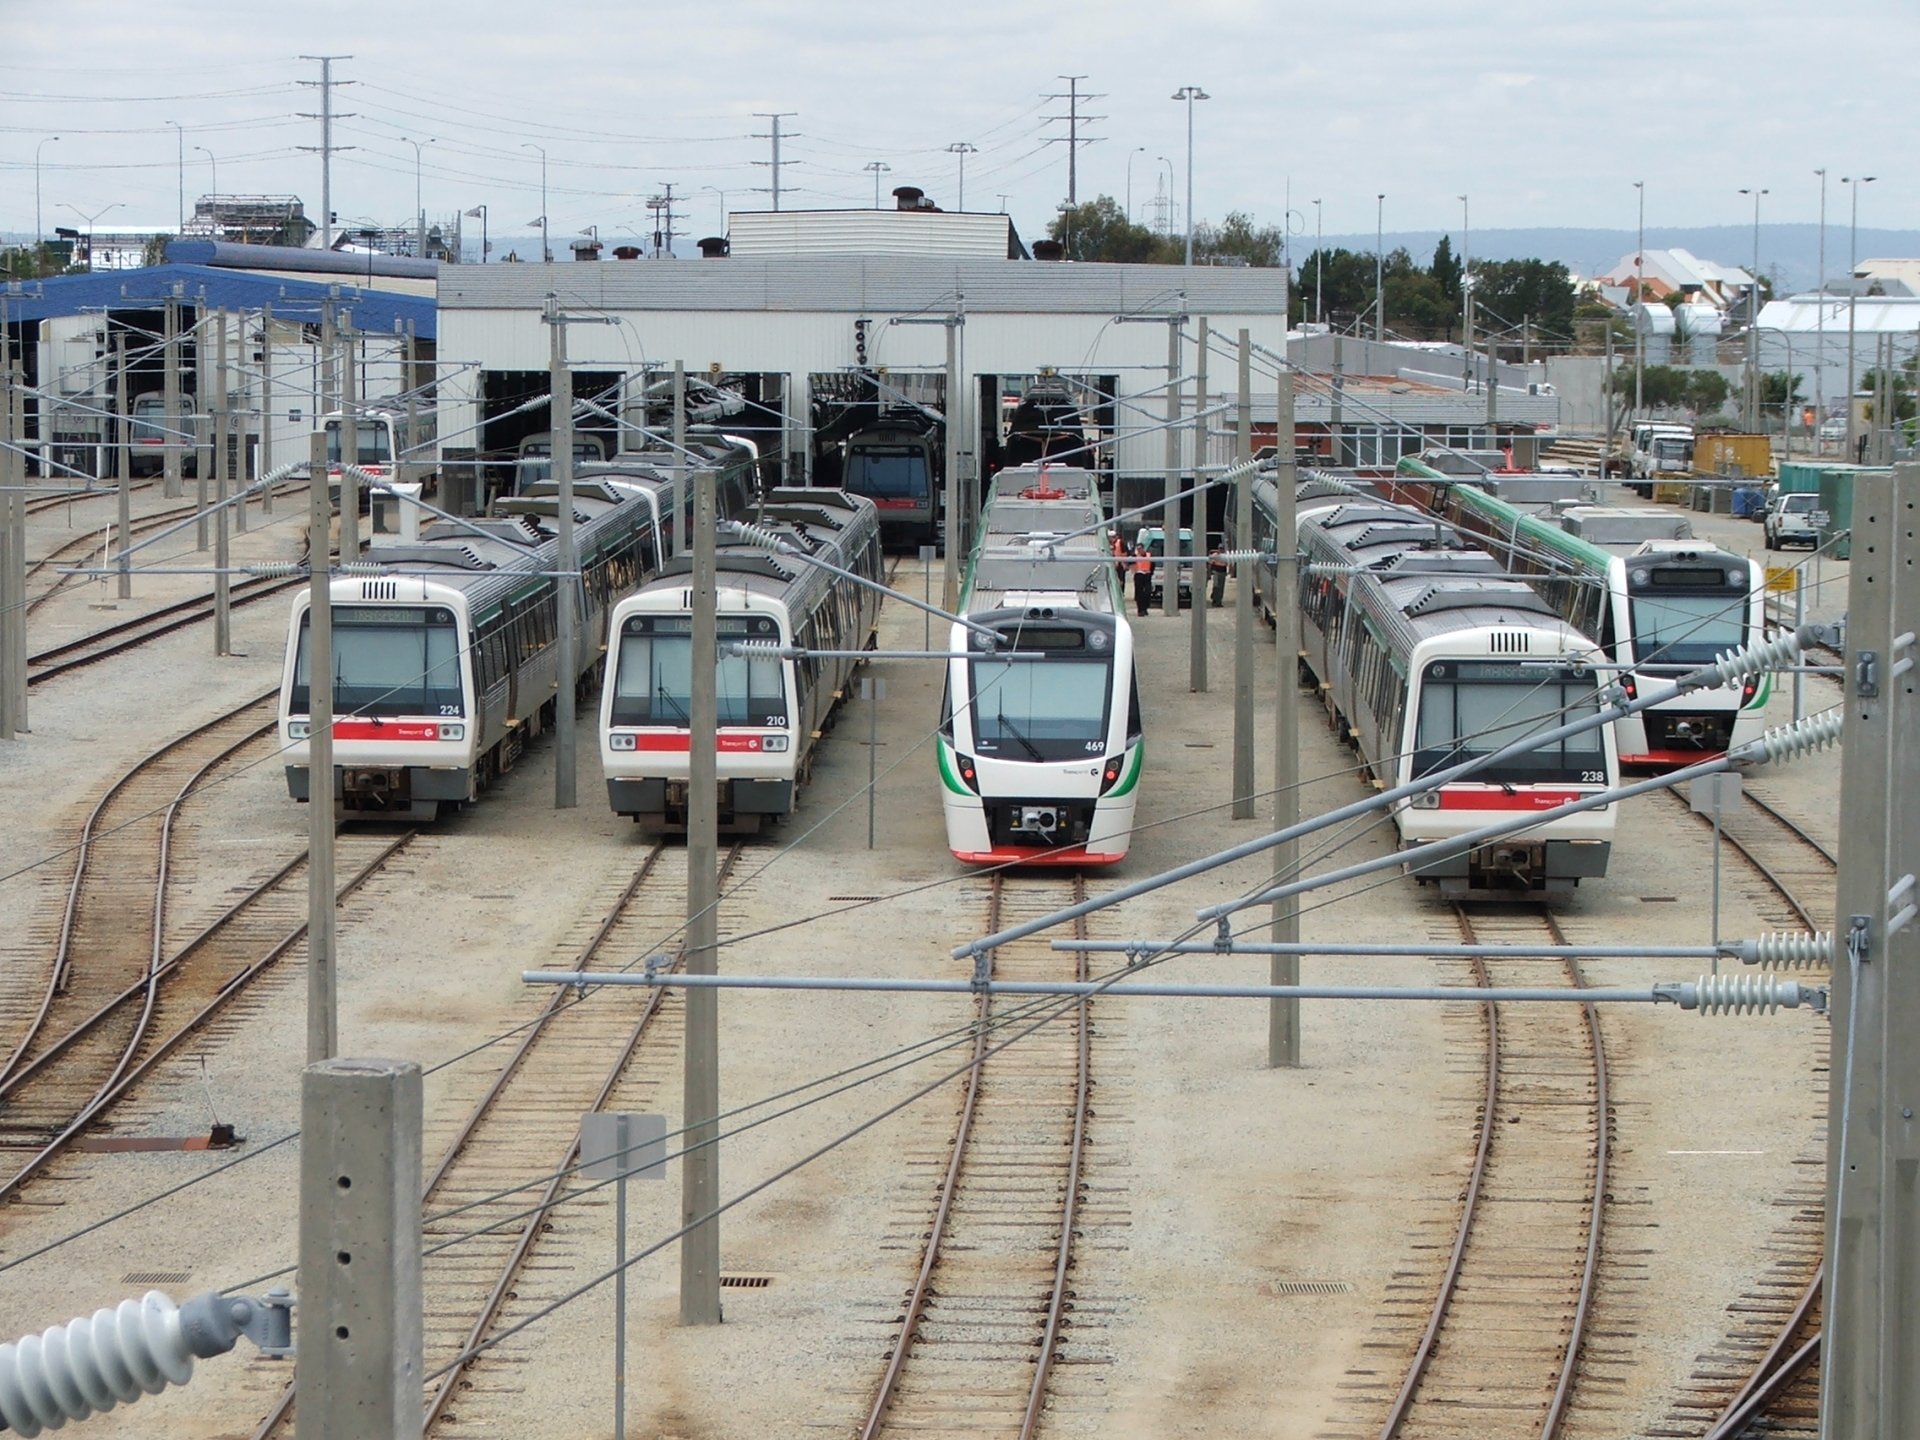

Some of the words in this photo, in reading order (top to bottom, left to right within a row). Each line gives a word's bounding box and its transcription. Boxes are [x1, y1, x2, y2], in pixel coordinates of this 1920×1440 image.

[440, 704, 460, 715] 224
[766, 715, 786, 726] 210
[1085, 741, 1104, 751] 469
[1581, 771, 1604, 782] 238
